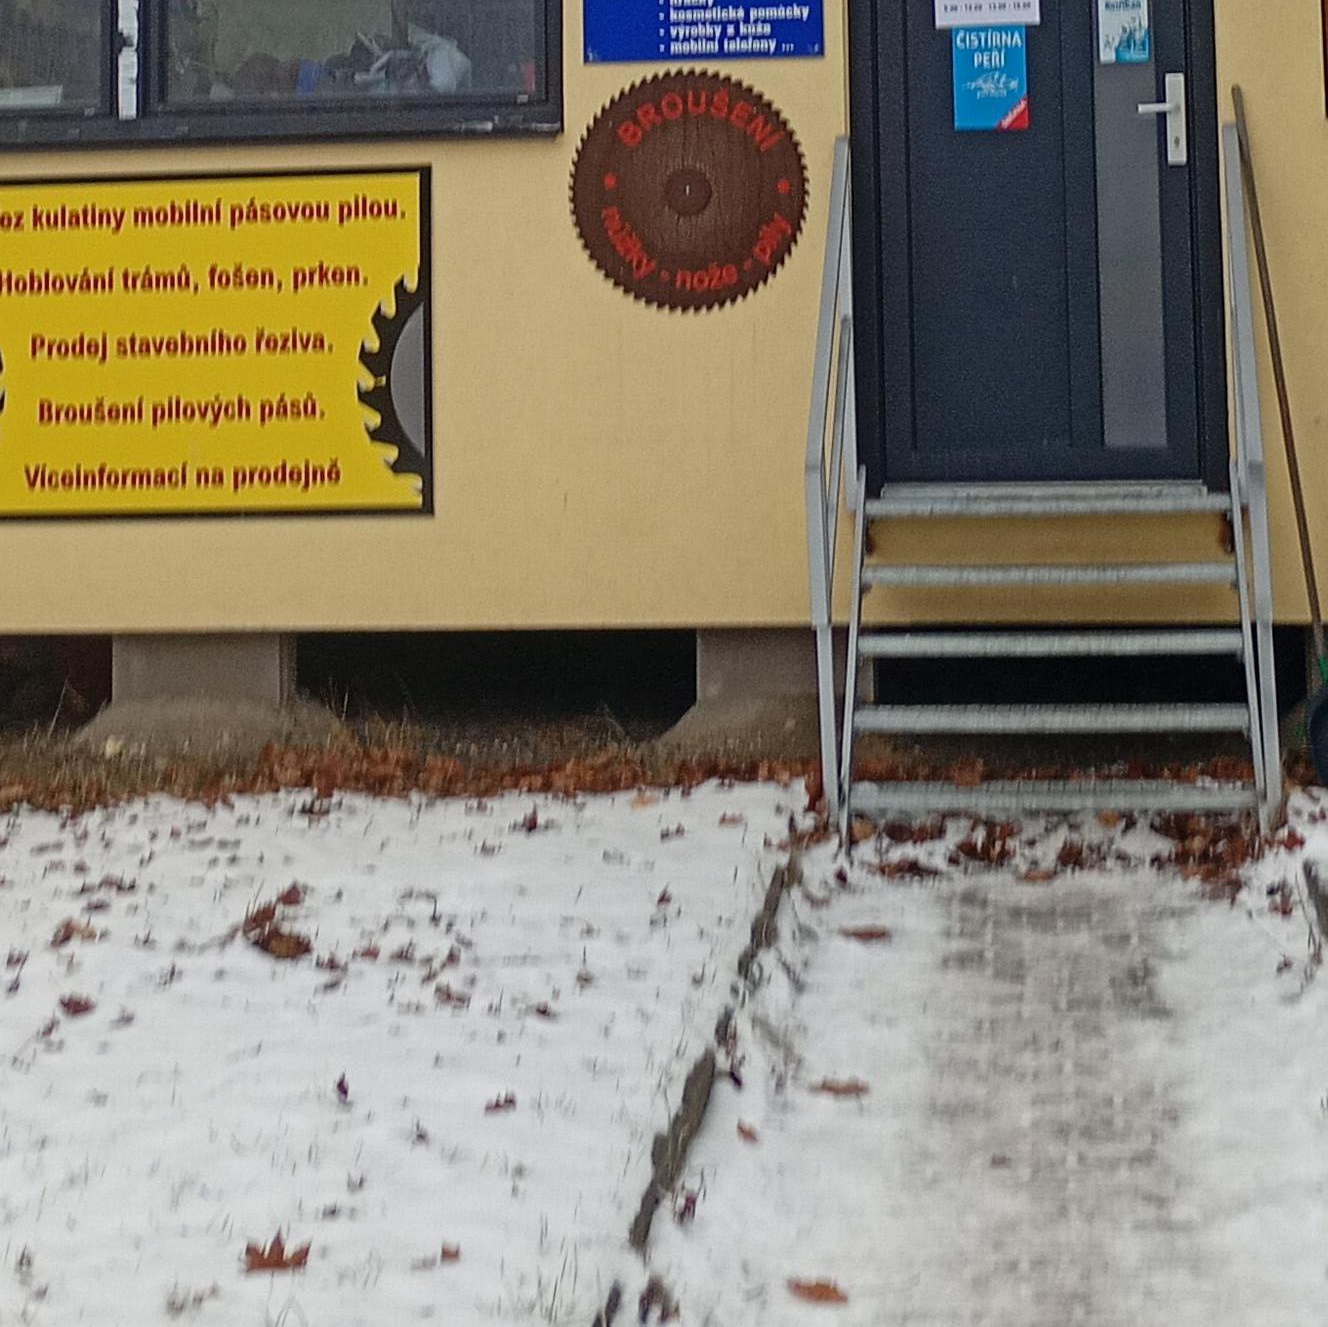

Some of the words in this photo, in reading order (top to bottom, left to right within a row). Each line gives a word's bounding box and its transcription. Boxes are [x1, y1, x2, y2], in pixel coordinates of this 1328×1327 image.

[670, 5, 745, 23] kosmetické
[670, 22, 721, 40] výrobky
[956, 28, 1022, 50] ČISTÍRNA
[974, 49, 1005, 70] PEŘÍ
[32, 202, 126, 236] kulatiny
[133, 197, 222, 227] mobilní
[230, 195, 330, 231] pásovou
[338, 192, 406, 229] pilou.
[122, 262, 199, 296] trámů,
[208, 261, 283, 295] fošen,
[292, 259, 369, 295] prken.
[30, 330, 108, 366] Prodej
[116, 327, 248, 359] stavebního
[256, 325, 334, 356] řeziva.
[38, 394, 144, 426] Broušení
[152, 392, 252, 431] pilových
[259, 390, 326, 428] pásů.
[196, 466, 225, 488] na
[232, 456, 343, 495] prodejně
